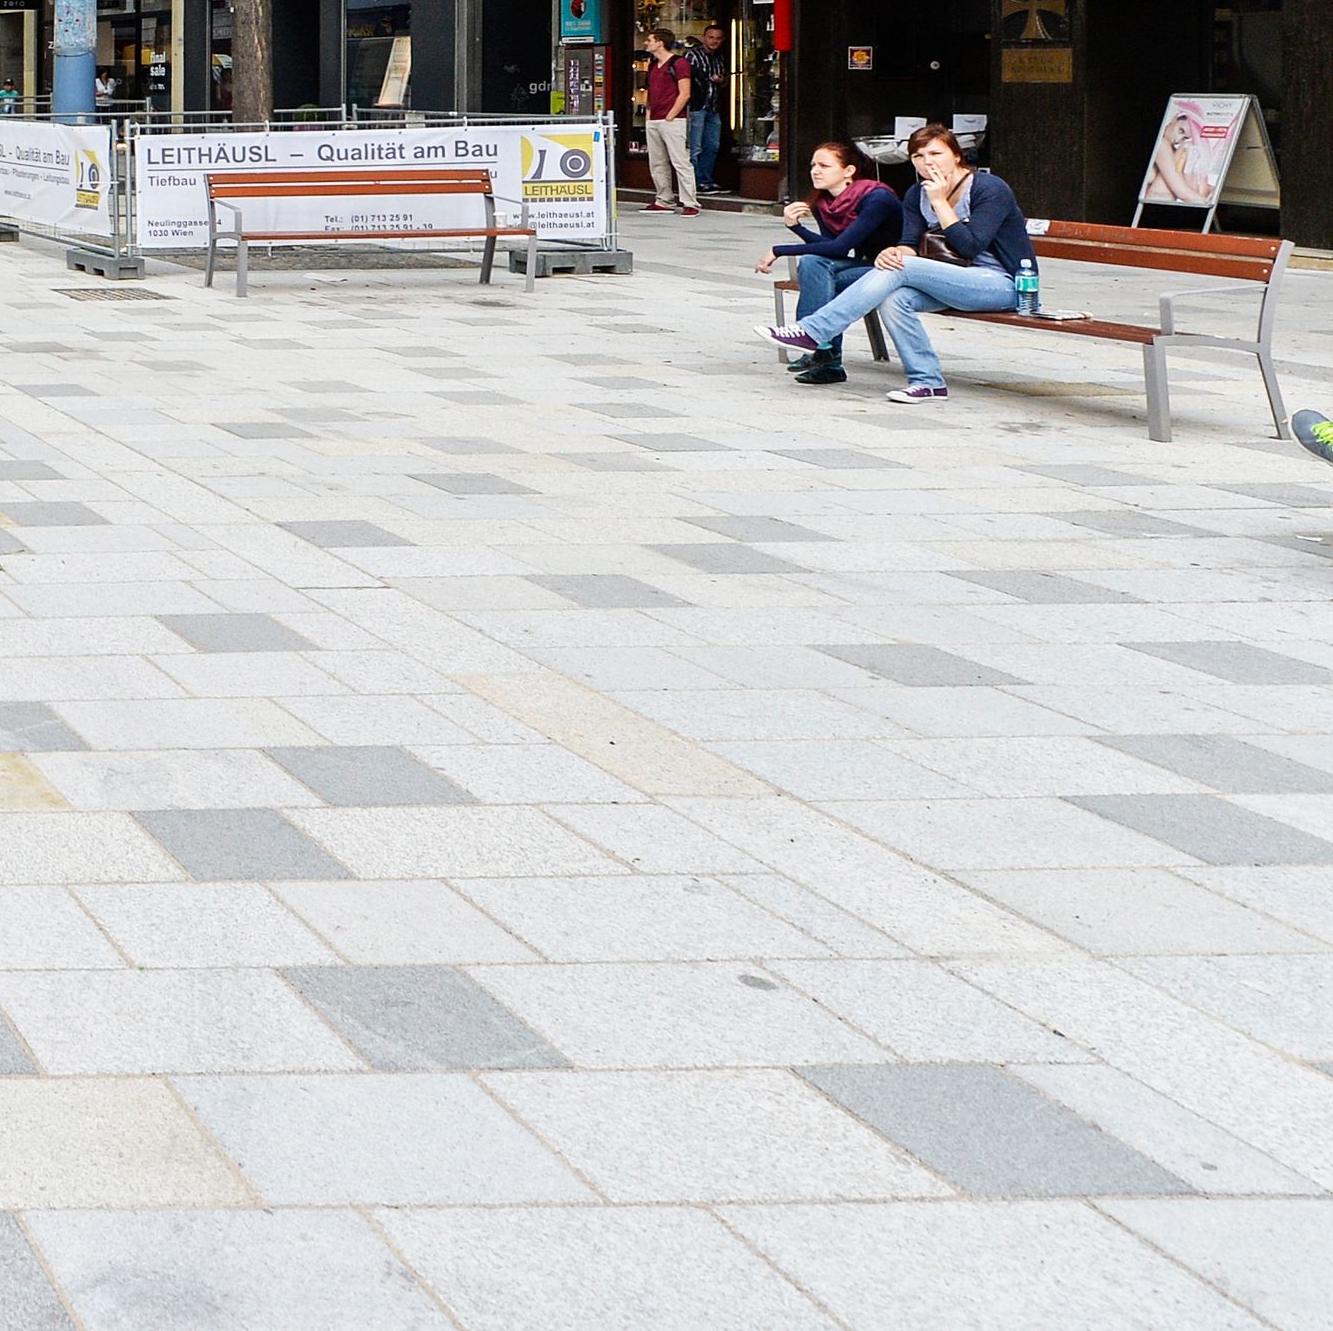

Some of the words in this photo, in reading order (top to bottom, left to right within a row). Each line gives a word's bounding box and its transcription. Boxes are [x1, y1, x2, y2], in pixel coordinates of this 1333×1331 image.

[149, 65, 166, 77] sale
[55, 150, 70, 166] Bau
[147, 142, 278, 165] LEITHÄUSL
[317, 142, 406, 162] Qualität
[413, 144, 446, 159] am
[454, 140, 499, 158] Bau
[147, 175, 197, 187] Tiefbau
[523, 184, 593, 197] LEITHÄUSL
[351, 214, 368, 224] (01)
[371, 214, 386, 222] 713
[389, 214, 400, 222] 25
[513, 210, 595, 220] ww.leithaeusl.at
[147, 220, 209, 228] Neulinggasse
[148, 229, 169, 237] 1030
[171, 229, 194, 237] Wien
